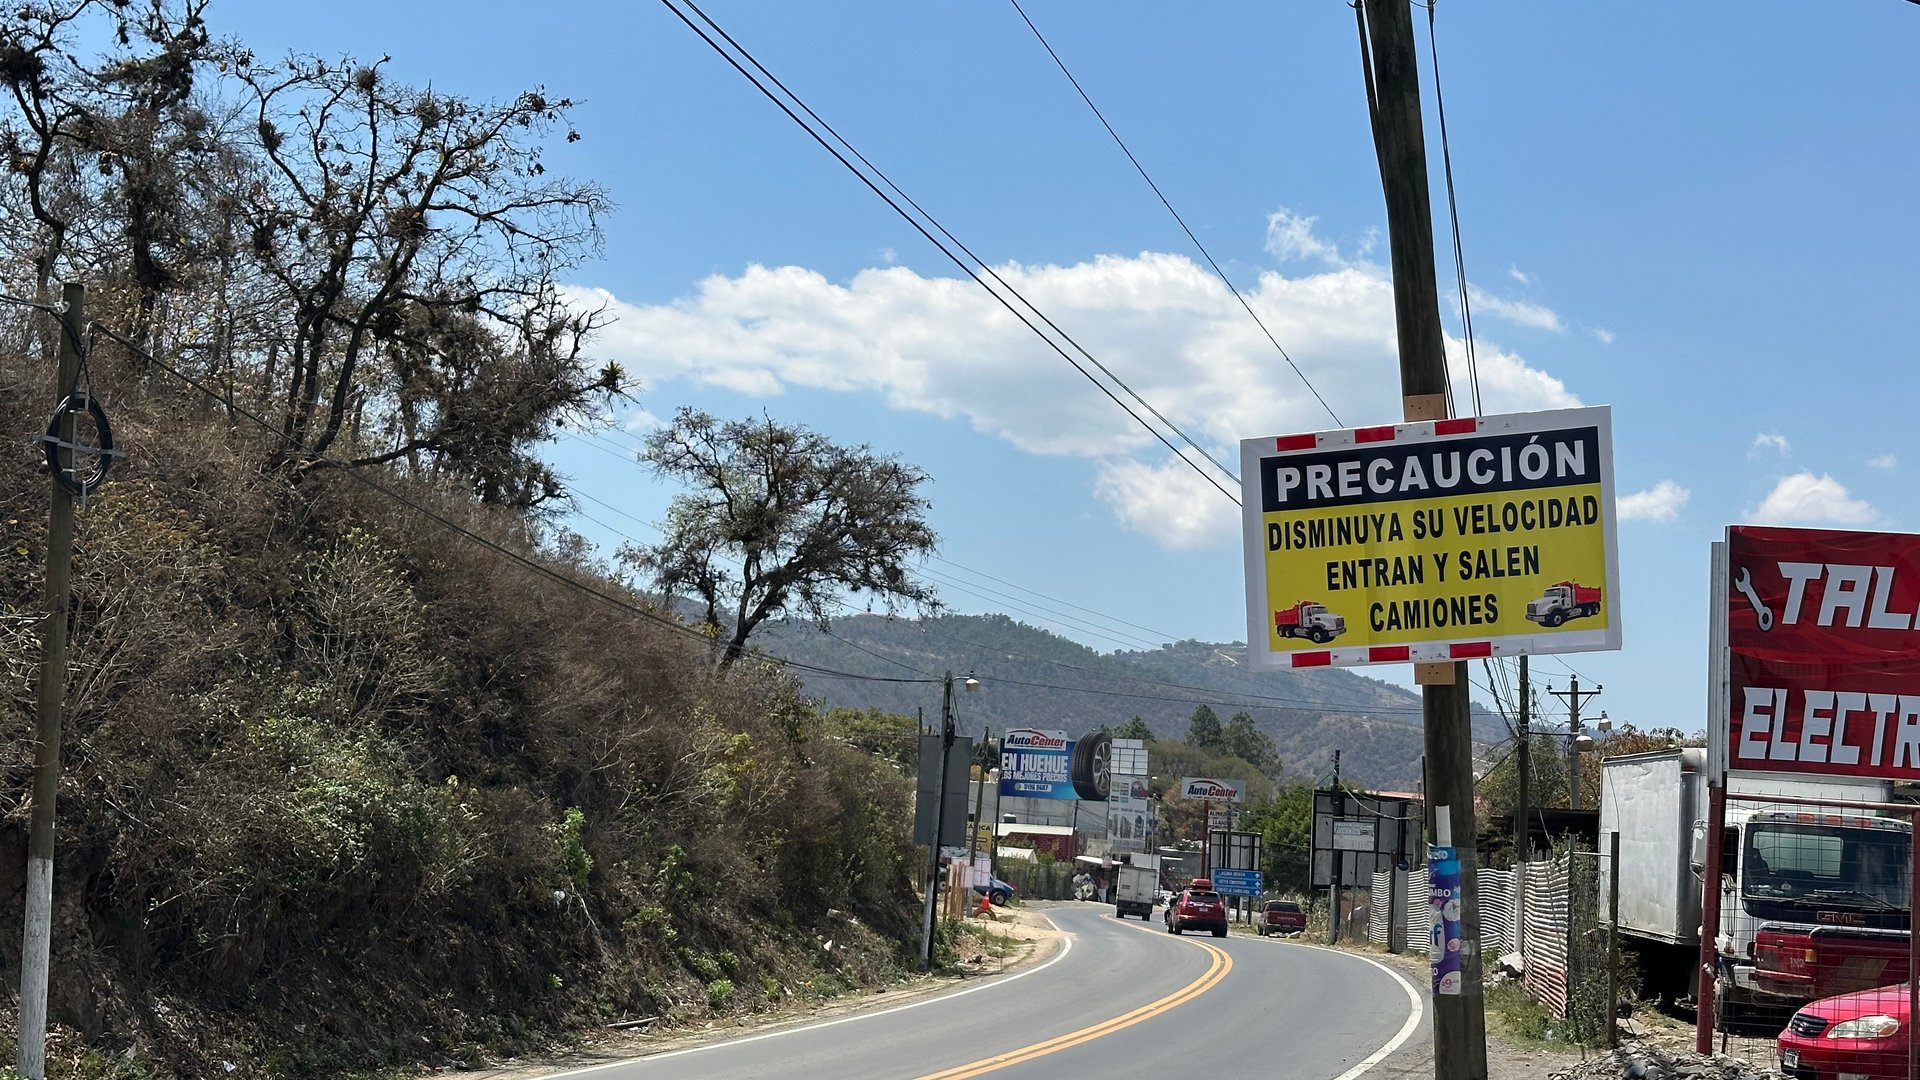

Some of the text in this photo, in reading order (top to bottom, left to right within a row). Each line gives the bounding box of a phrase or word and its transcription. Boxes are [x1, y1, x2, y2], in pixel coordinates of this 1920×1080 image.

[1276, 435, 1585, 502] PRECAUCIÓN
[1268, 495, 1598, 551] DISMINUYA SU VELOCIDAD
[1326, 545, 1539, 591] ENTRAN Y SALEN
[1369, 593, 1498, 632] CAMIONES
[1777, 561, 1920, 631] TAL
[1007, 734, 1066, 747] AutoCenter
[1001, 752, 1068, 773] EN HUEHUE
[1187, 784, 1238, 798] AutoCenter
[1817, 910, 1866, 924] GMC
